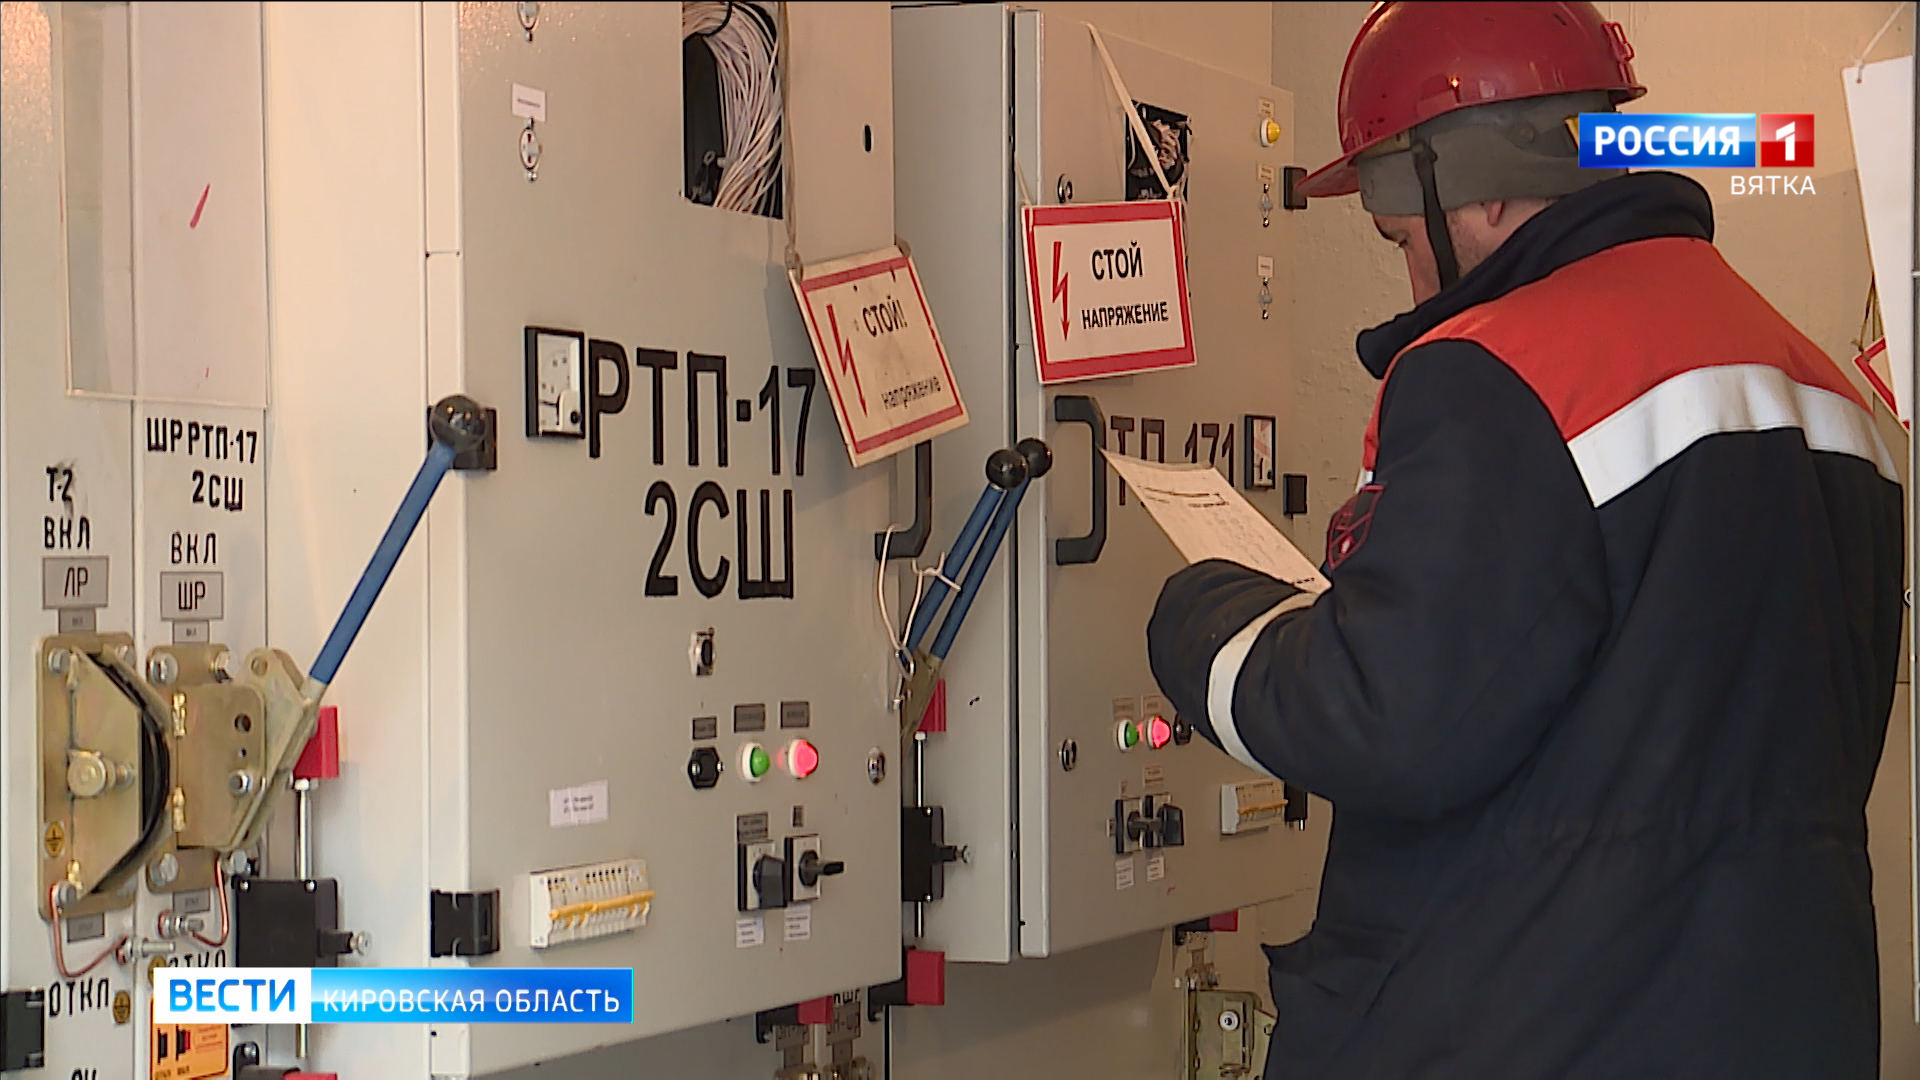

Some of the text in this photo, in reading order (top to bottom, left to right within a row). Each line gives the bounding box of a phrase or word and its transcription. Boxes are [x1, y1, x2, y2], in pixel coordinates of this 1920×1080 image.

[1091, 240, 1143, 280] СТОЙ
[862, 295, 908, 338] СТОЙ!
[1081, 301, 1169, 330] НАПРЯЖЕНИЕ
[588, 338, 816, 477] РТП-17
[146, 417, 258, 464] ШР РТП-17
[46, 467, 73, 501] Т-2
[191, 470, 244, 511] 2СШ
[44, 516, 91, 550] ВКЛ
[171, 532, 217, 565] ВКЛ
[644, 480, 794, 599] 2СШ
[64, 566, 89, 598] ЛР
[177, 581, 207, 610] ШР
[49, 978, 110, 1018] ОТКЛ
